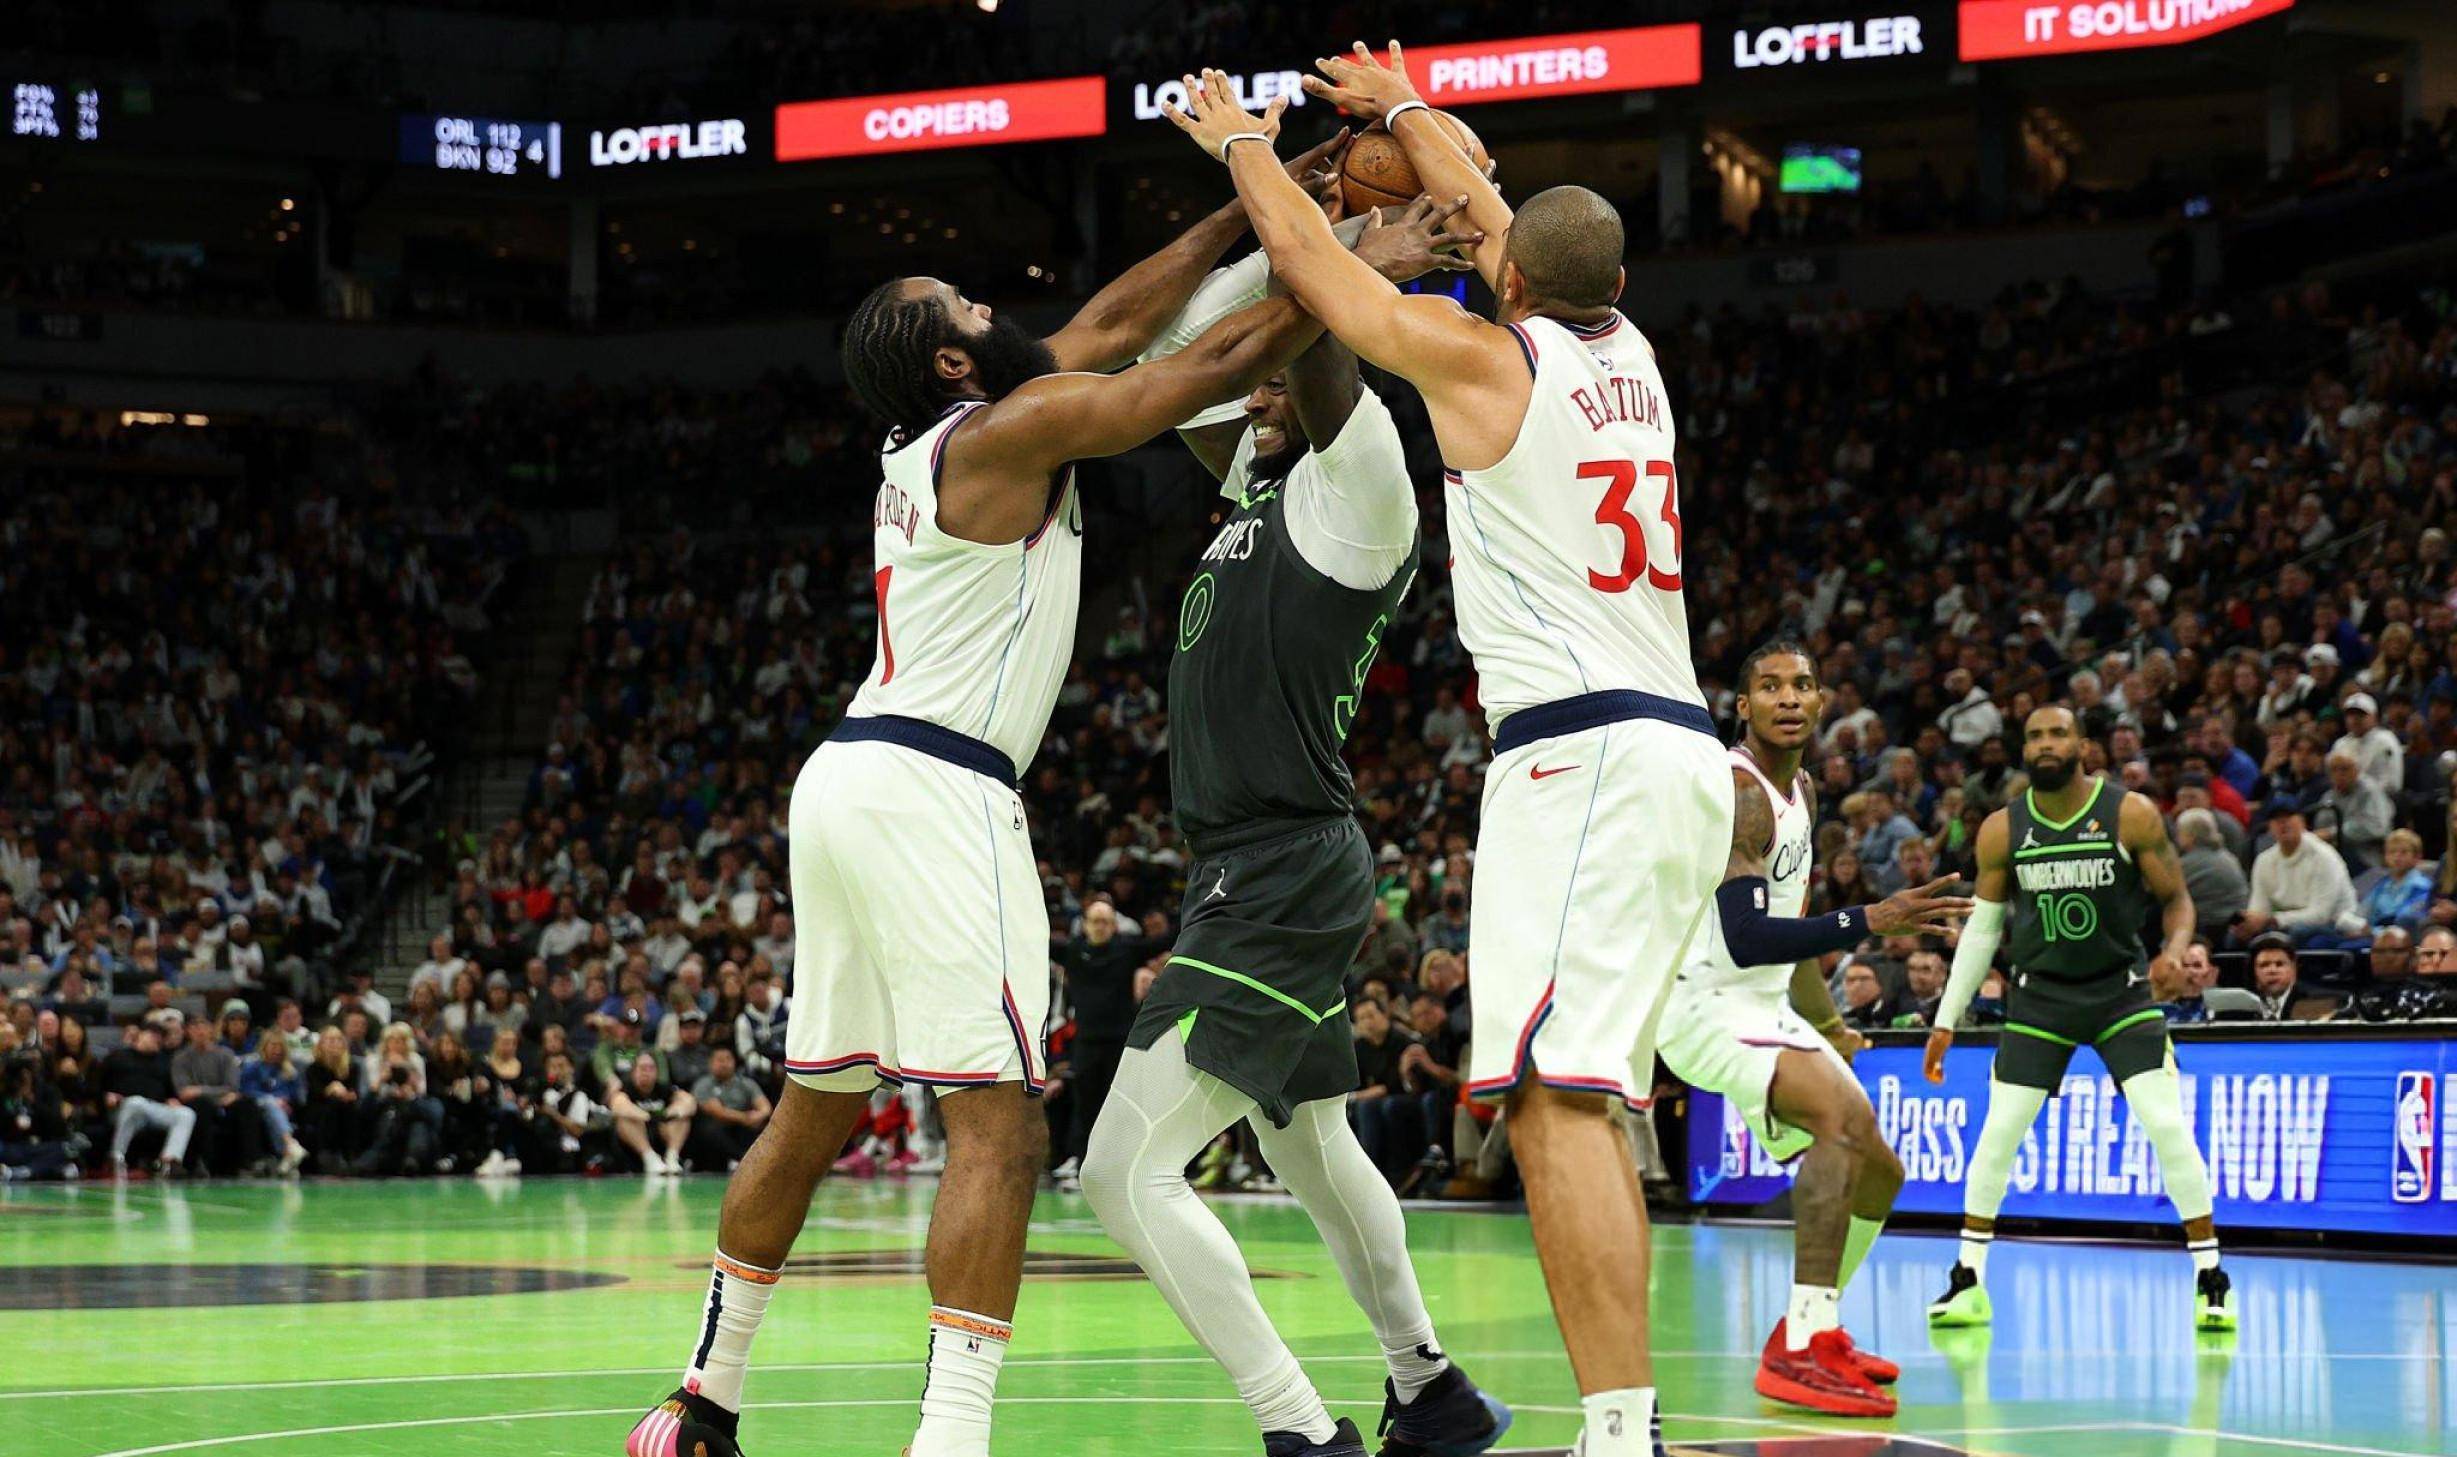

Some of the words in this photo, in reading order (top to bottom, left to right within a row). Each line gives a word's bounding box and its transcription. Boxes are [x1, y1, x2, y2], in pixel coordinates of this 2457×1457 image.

[1734, 16, 1924, 68] LOFFLER
[2025, 7, 2060, 42] IT
[2067, 0, 2252, 38] SOLUTIO
[1430, 46, 1608, 93] PRINTERS
[864, 98, 1010, 141] COPIERS
[1134, 70, 1305, 120] LOLER
[435, 117, 480, 146] ORL
[486, 122, 521, 150] 112
[525, 138, 544, 164] 4
[591, 119, 747, 166] LOFFLER
[436, 142, 480, 170] BKN
[486, 146, 517, 175] 92
[1570, 377, 1663, 433] BATUM
[875, 484, 920, 547] ARDEN
[1576, 460, 1682, 593] 33
[2037, 893, 2097, 942] 10
[1878, 1075, 1968, 1183] Pass
[2210, 1073, 2330, 1202] NOW
